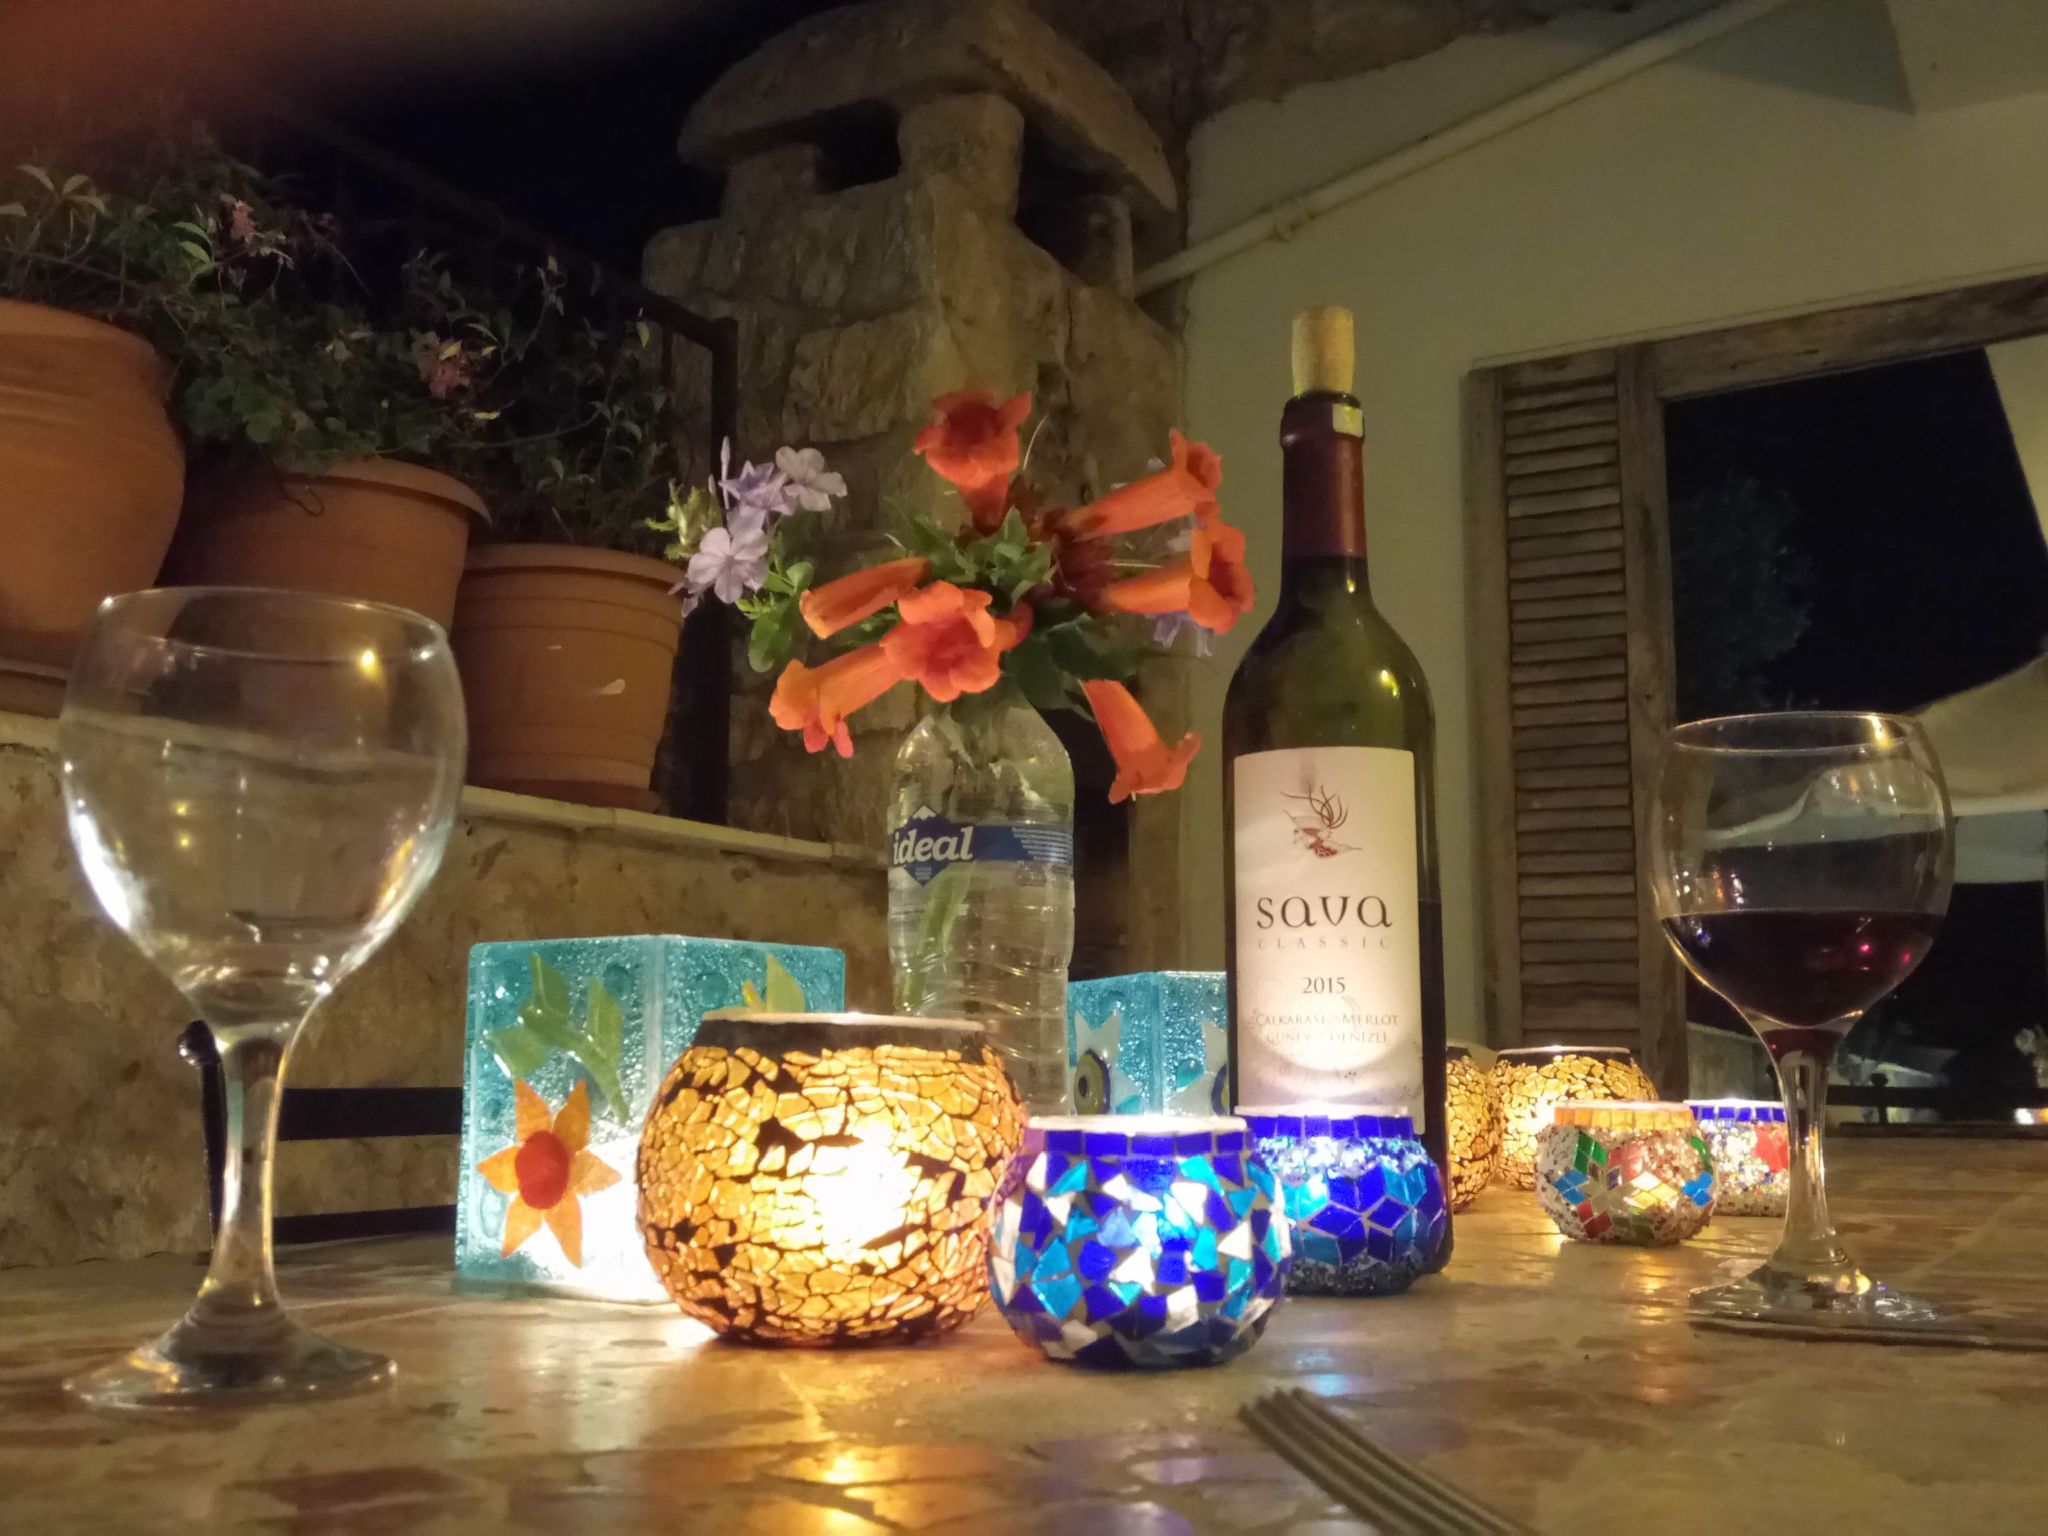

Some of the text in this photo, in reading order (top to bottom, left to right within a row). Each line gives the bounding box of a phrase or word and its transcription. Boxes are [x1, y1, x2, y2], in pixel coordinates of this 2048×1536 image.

[893, 827, 974, 865] ideal
[1258, 936, 1391, 950] CLASSIC
[1302, 976, 1346, 995] 2015
[1342, 1013, 1399, 1026] MERLOT
